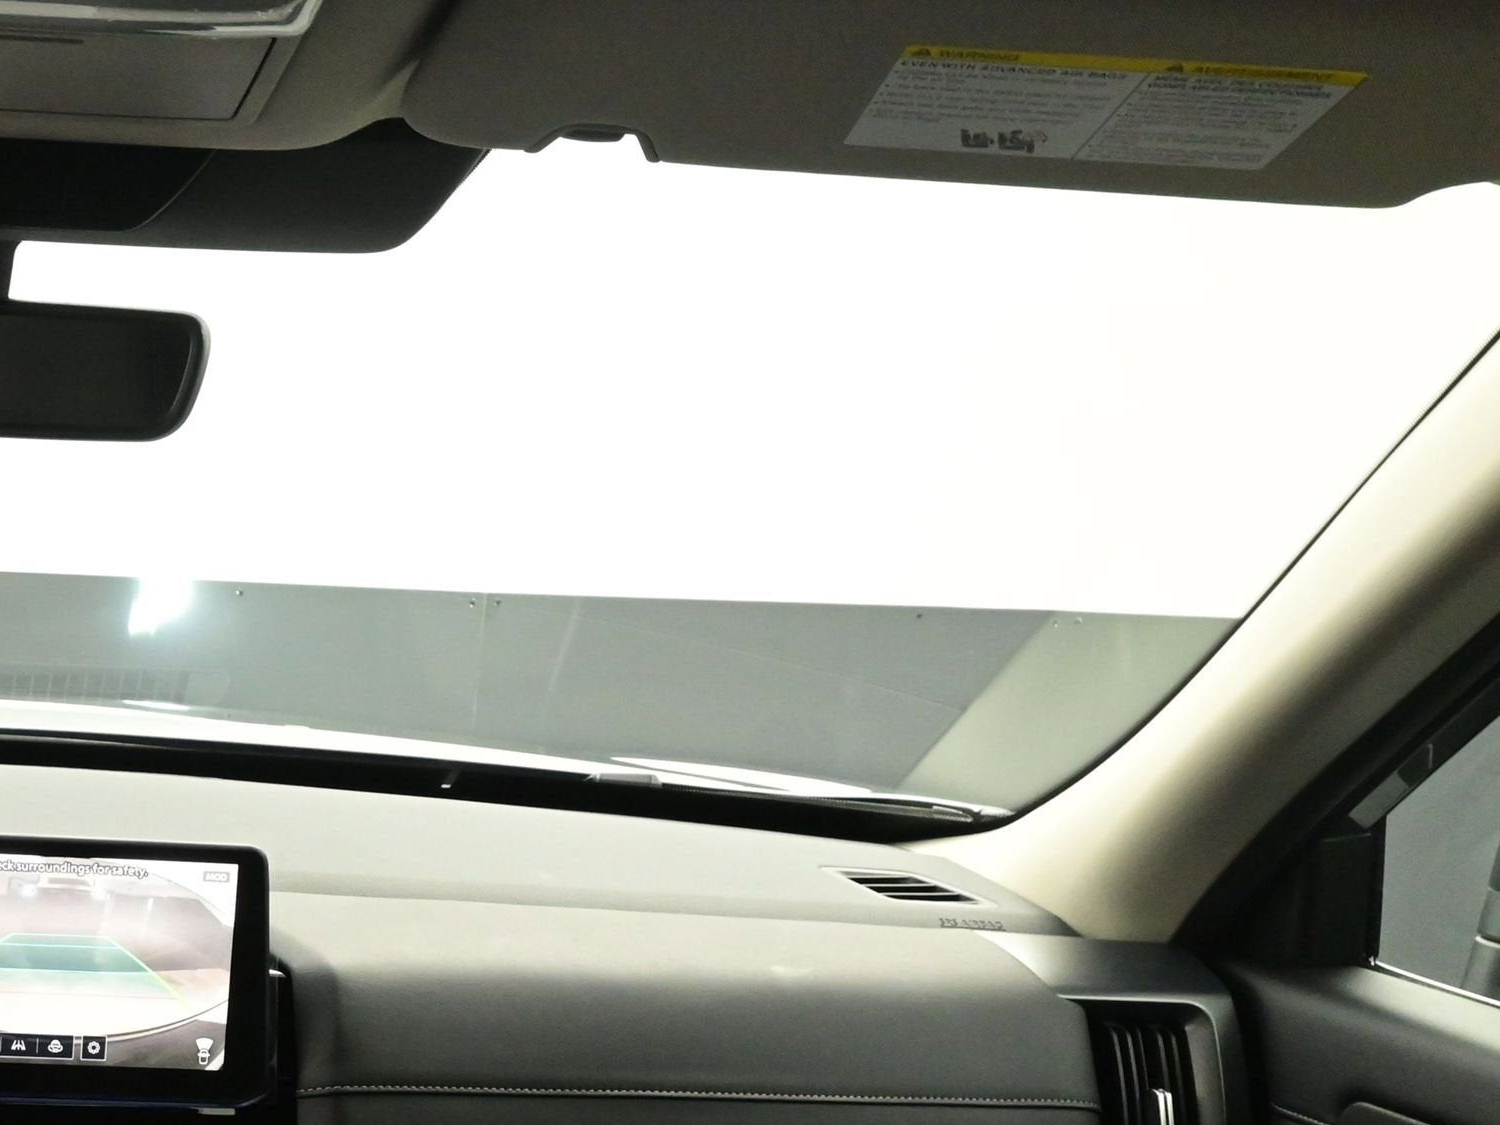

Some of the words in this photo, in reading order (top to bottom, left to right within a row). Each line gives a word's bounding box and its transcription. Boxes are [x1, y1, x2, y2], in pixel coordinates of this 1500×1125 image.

[15, 861, 90, 877] surroundings
[91, 864, 110, 876] for
[110, 865, 149, 879] safety.
